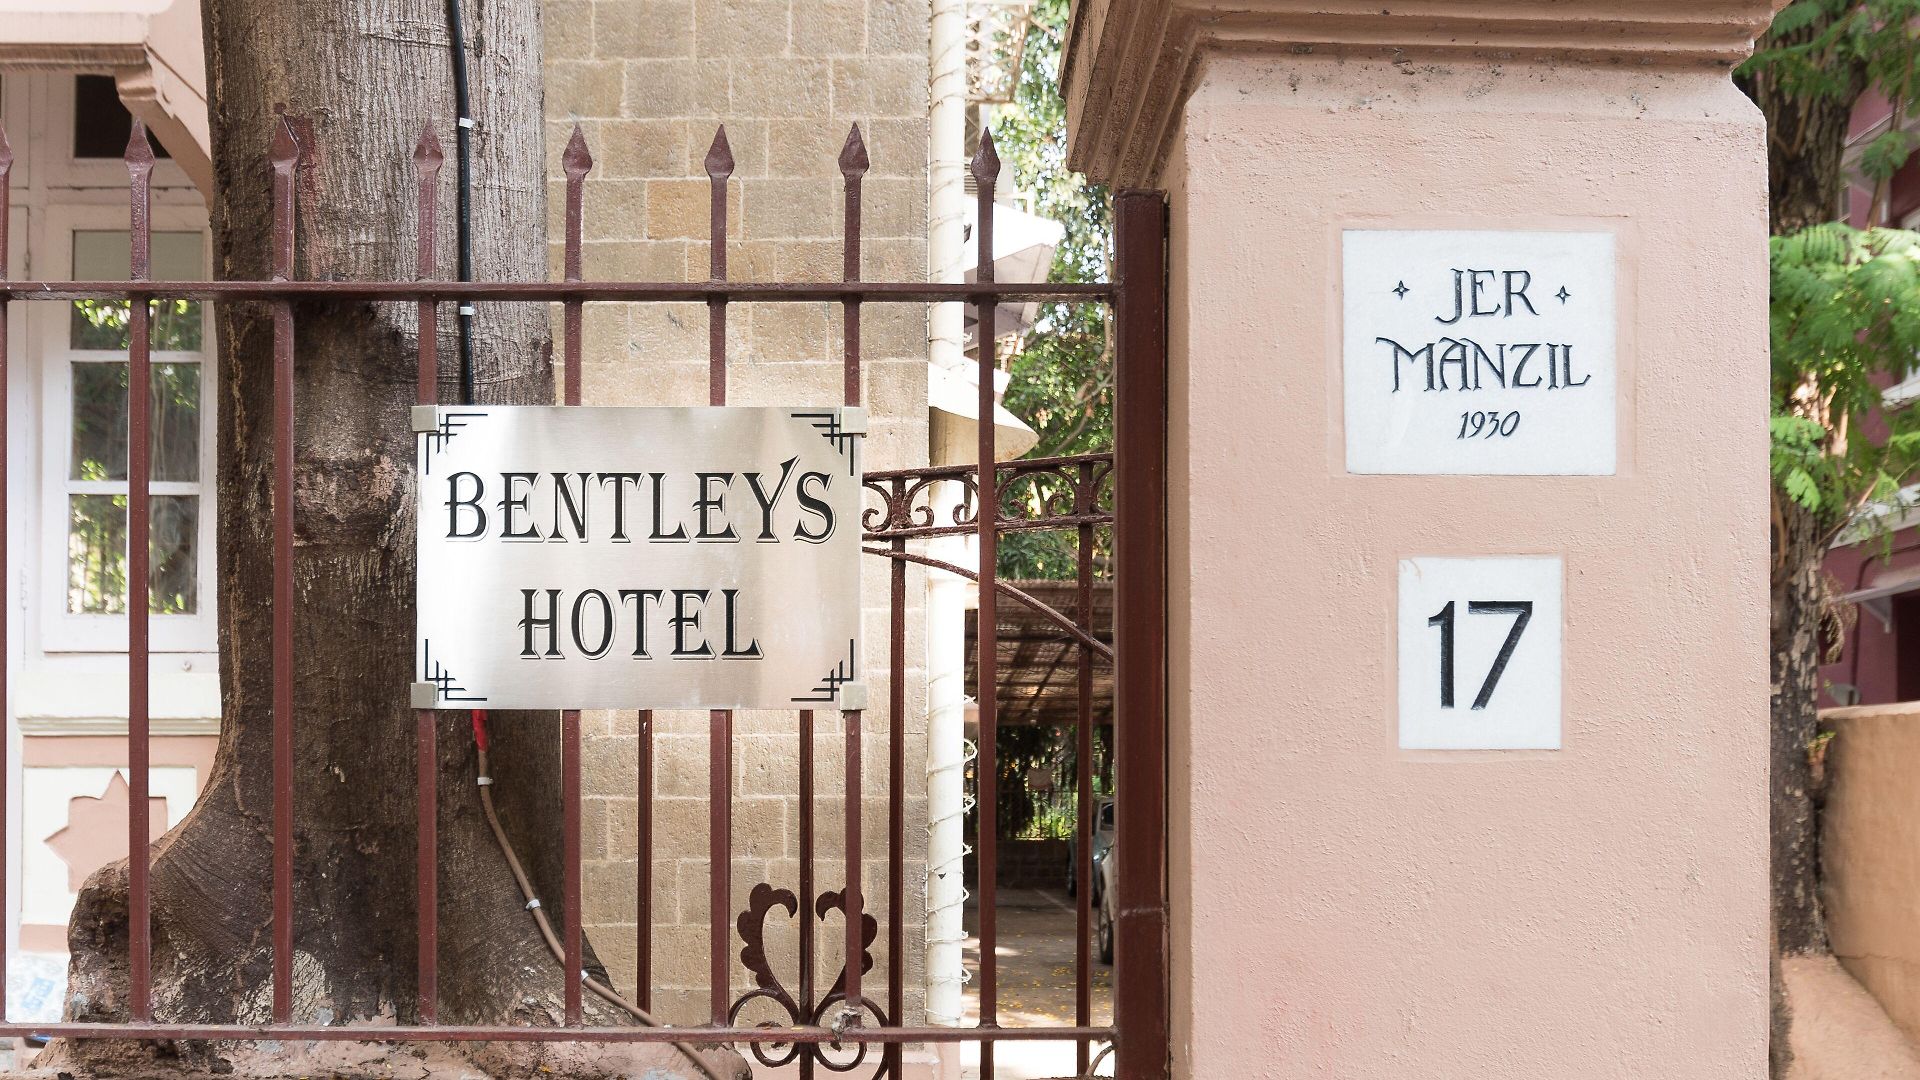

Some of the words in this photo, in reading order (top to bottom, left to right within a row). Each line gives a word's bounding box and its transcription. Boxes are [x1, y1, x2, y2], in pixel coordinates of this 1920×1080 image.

[1435, 268, 1540, 325] JER
[1375, 336, 1591, 393] MANZIL
[1457, 410, 1521, 439] 1930
[444, 456, 836, 544] BENTLEY'S
[517, 588, 764, 661] HOTEL
[1428, 600, 1533, 710] 17
